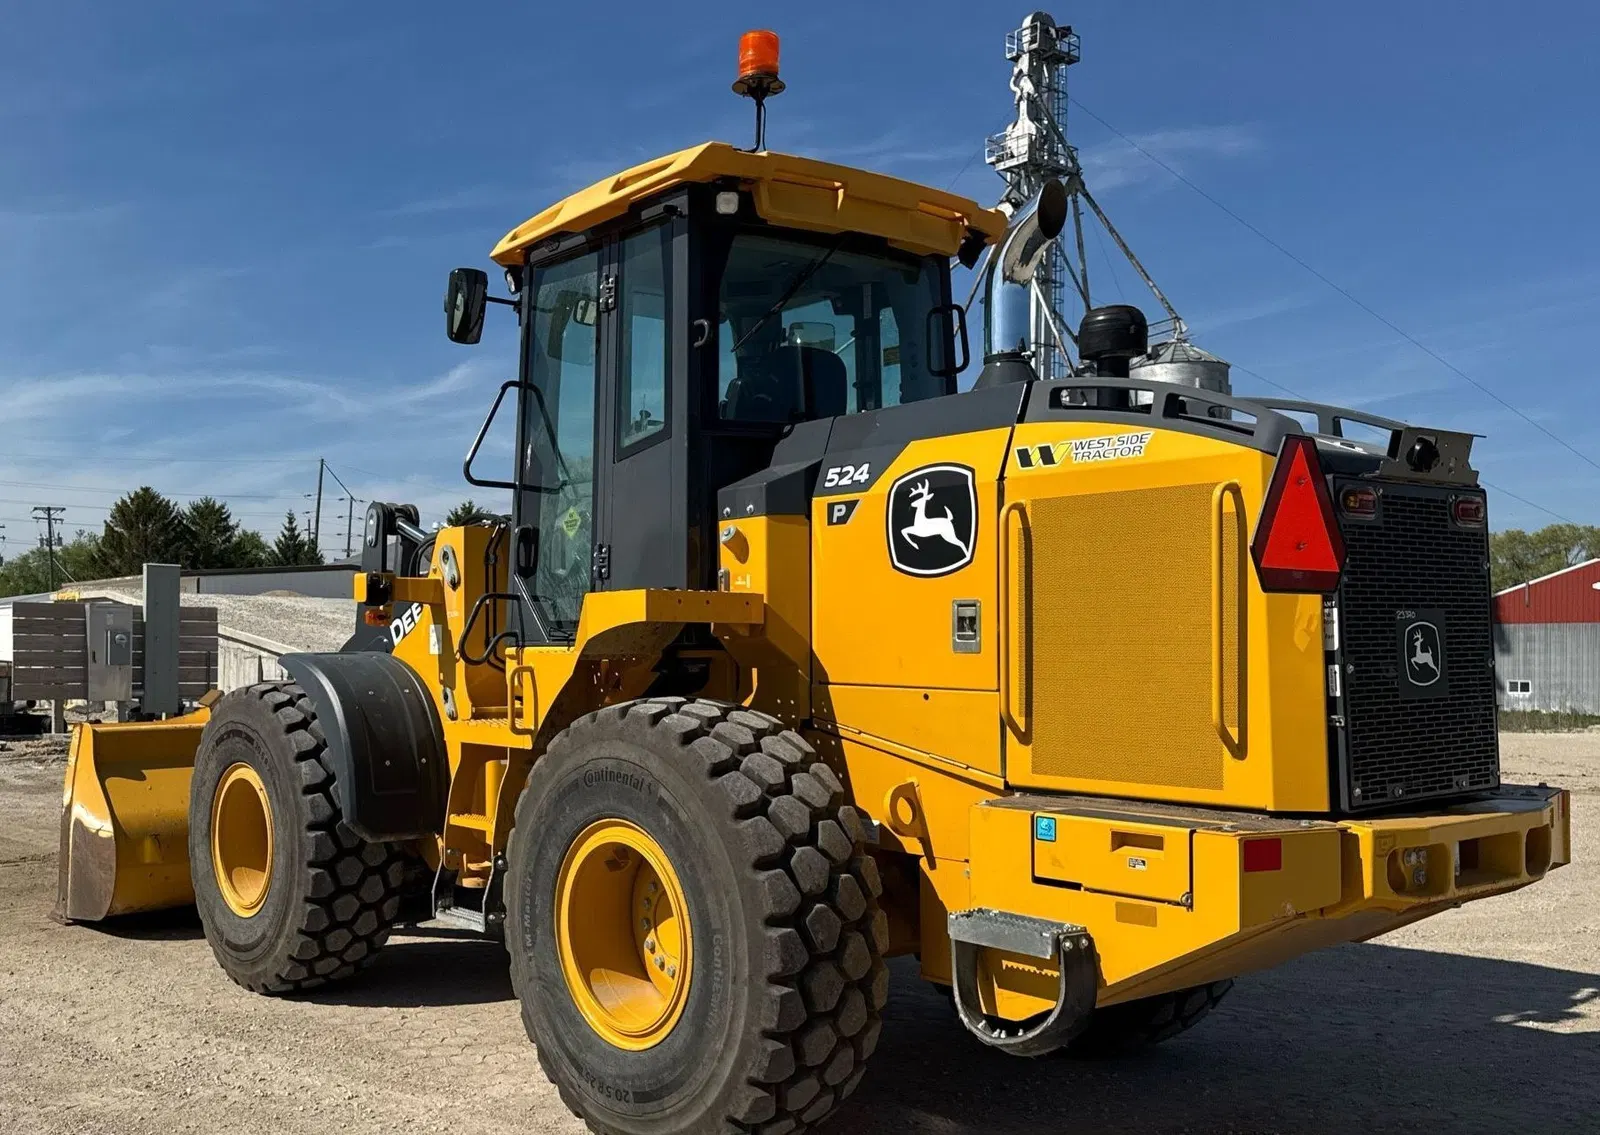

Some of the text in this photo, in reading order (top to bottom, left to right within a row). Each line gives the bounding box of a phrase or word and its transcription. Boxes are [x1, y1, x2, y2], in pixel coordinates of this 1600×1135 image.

[1073, 432, 1151, 452] WEST SIDE
[1072, 445, 1143, 462] TRACTOR
[824, 462, 870, 488] 524
[832, 504, 847, 523] P
[583, 766, 644, 793] Continental
